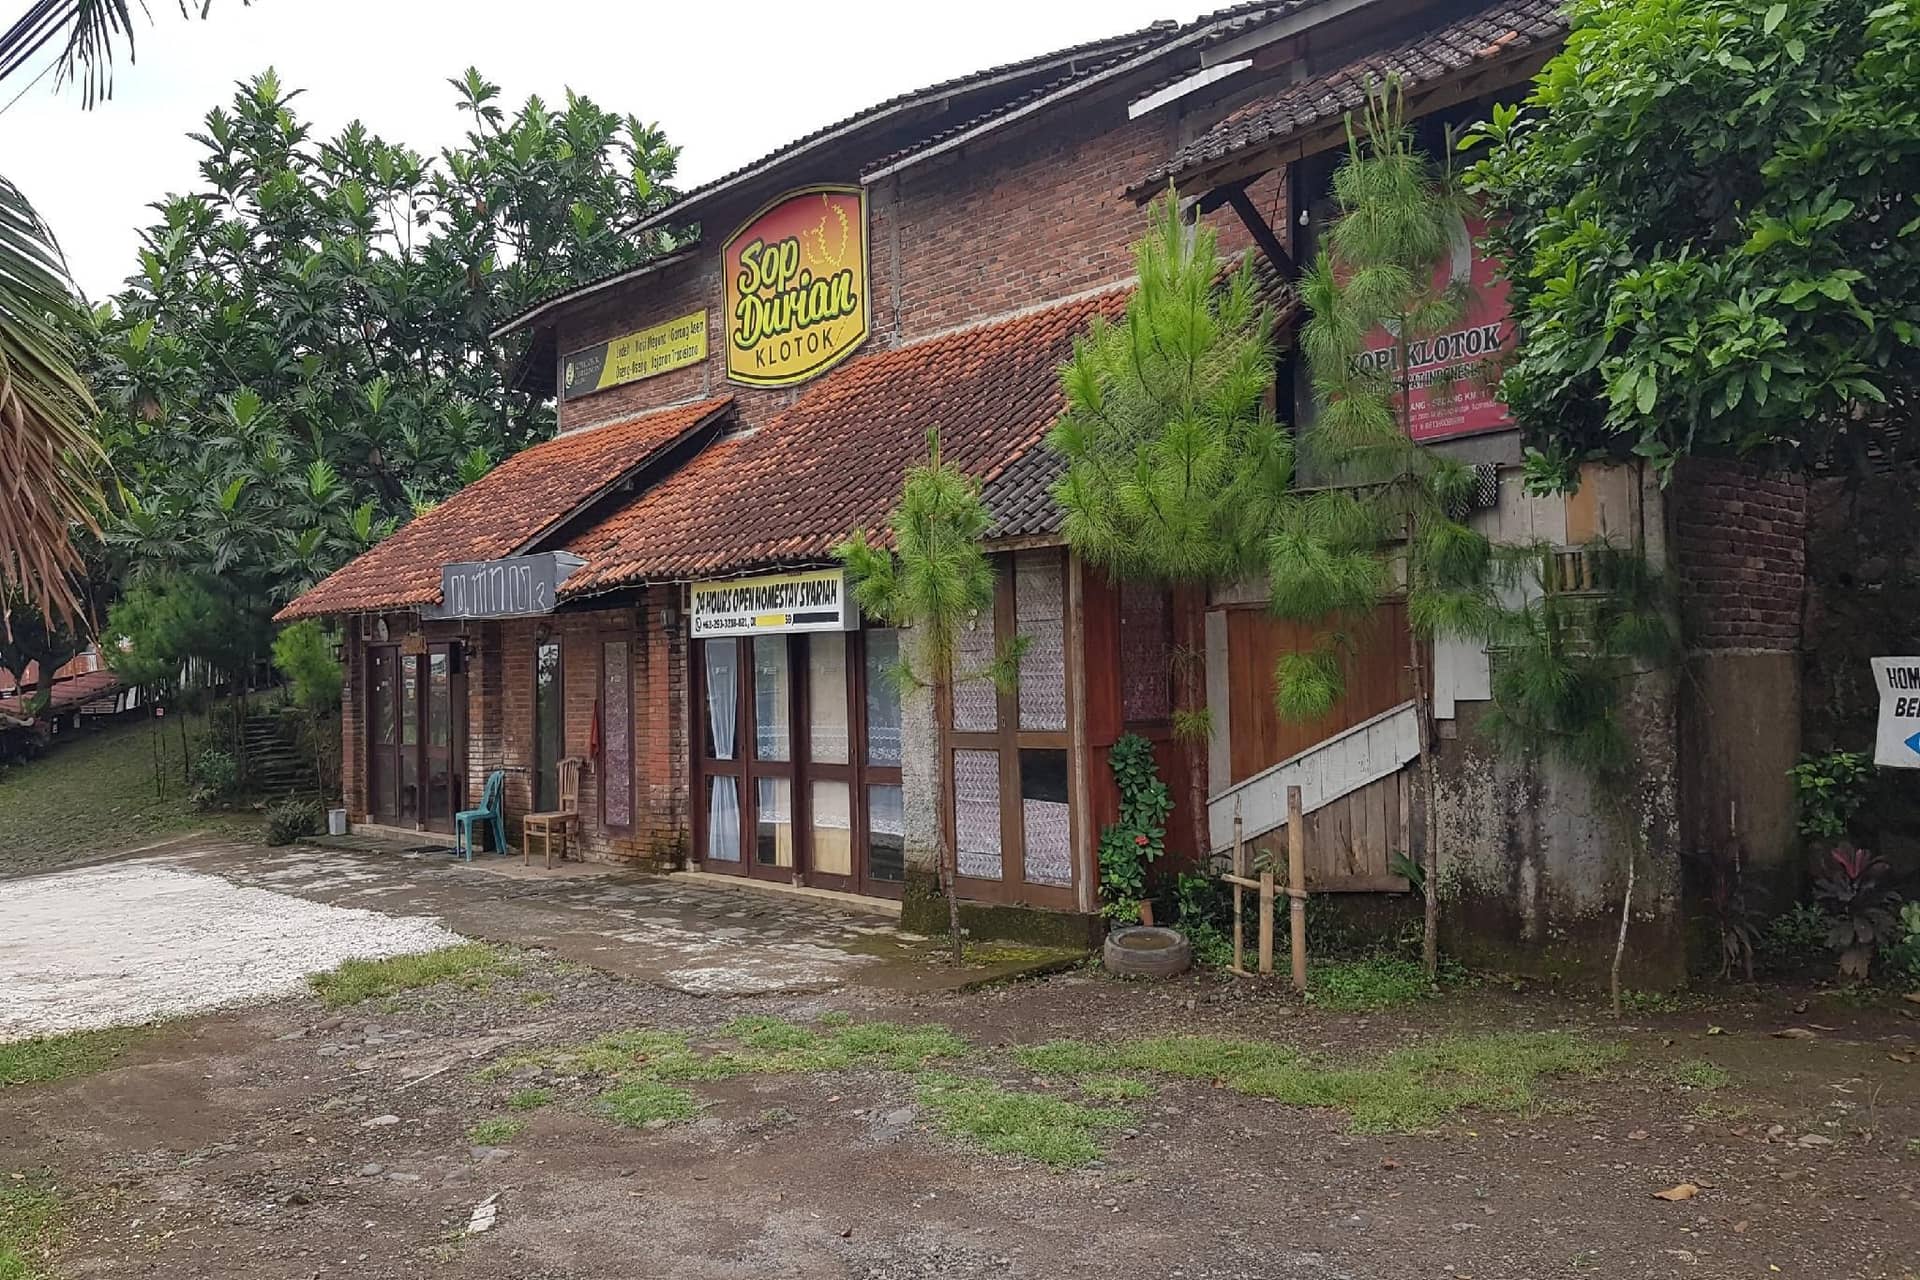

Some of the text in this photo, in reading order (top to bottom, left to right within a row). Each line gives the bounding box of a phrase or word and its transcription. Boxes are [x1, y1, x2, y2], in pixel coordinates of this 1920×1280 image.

[738, 238, 799, 293] Sop
[734, 270, 857, 348] Durian
[756, 327, 833, 369] KLOTOK
[1408, 322, 1502, 368] KLOTOK
[695, 579, 838, 615] 24 HOURS OPEN HOMESTAY SYARIAH
[1895, 696, 1920, 718] BE
